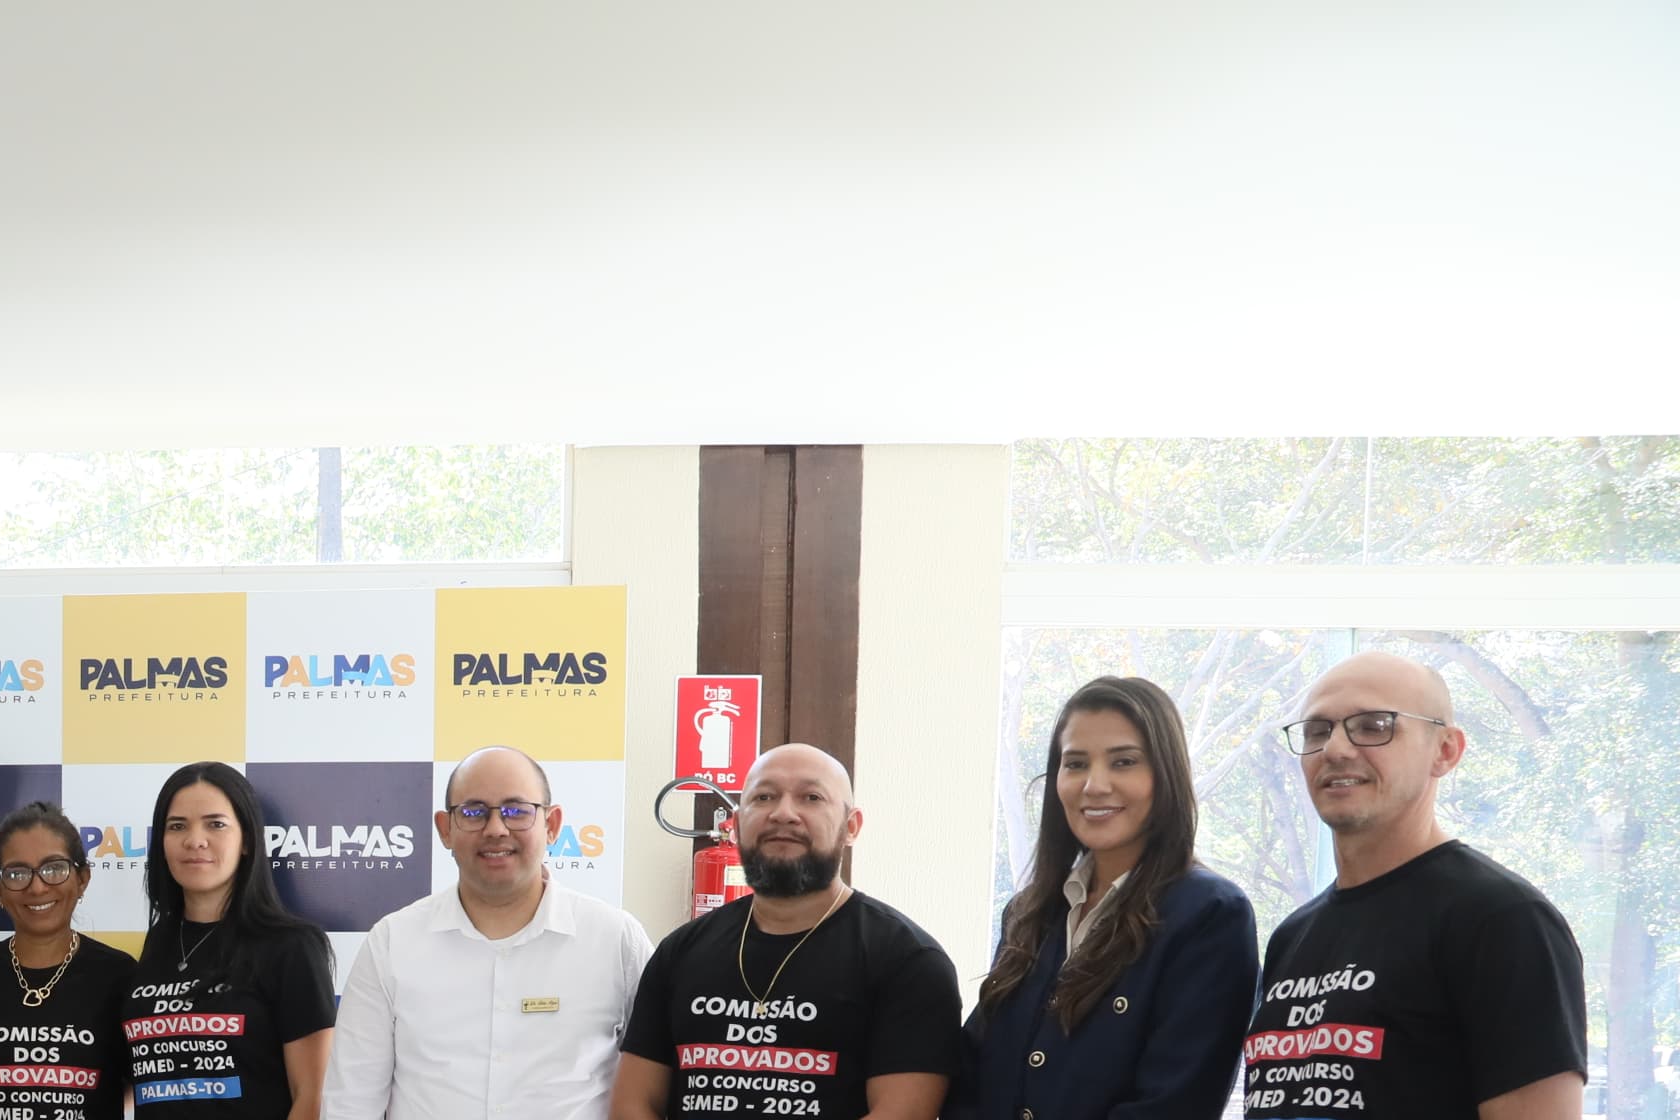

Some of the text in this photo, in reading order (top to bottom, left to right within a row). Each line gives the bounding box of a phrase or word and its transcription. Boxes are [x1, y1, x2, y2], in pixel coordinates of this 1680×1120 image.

[80, 656, 228, 690] PALMAS
[264, 653, 416, 687] PALMAS
[453, 652, 607, 686] PALMAS
[89, 692, 218, 701] PREFEITURA
[273, 690, 407, 699] PREFEITURA
[462, 689, 597, 697] PREFEITURA
[717, 773, 736, 784] BC
[264, 824, 414, 858] PALMAS
[272, 861, 404, 870] PREFEITURA
[153, 999, 194, 1014] DOS
[1286, 1000, 1327, 1027] DOS
[125, 1017, 240, 1040] APROVADOS
[726, 1023, 778, 1044] DOS
[14, 1047, 60, 1063] DOS
[132, 1040, 227, 1058] NO CONCURSO
[133, 1059, 175, 1077] SEMED
[193, 1056, 235, 1071] 2024
[681, 1047, 831, 1072] APROVADOS
[141, 1082, 226, 1100] PALMAS-TO
[688, 1075, 816, 1094] NO CONCURSO
[10, 1091, 85, 1105] CONCURSO
[682, 1095, 739, 1112] SEMED
[762, 1097, 821, 1116] 2024
[1301, 1086, 1365, 1110] 2024
